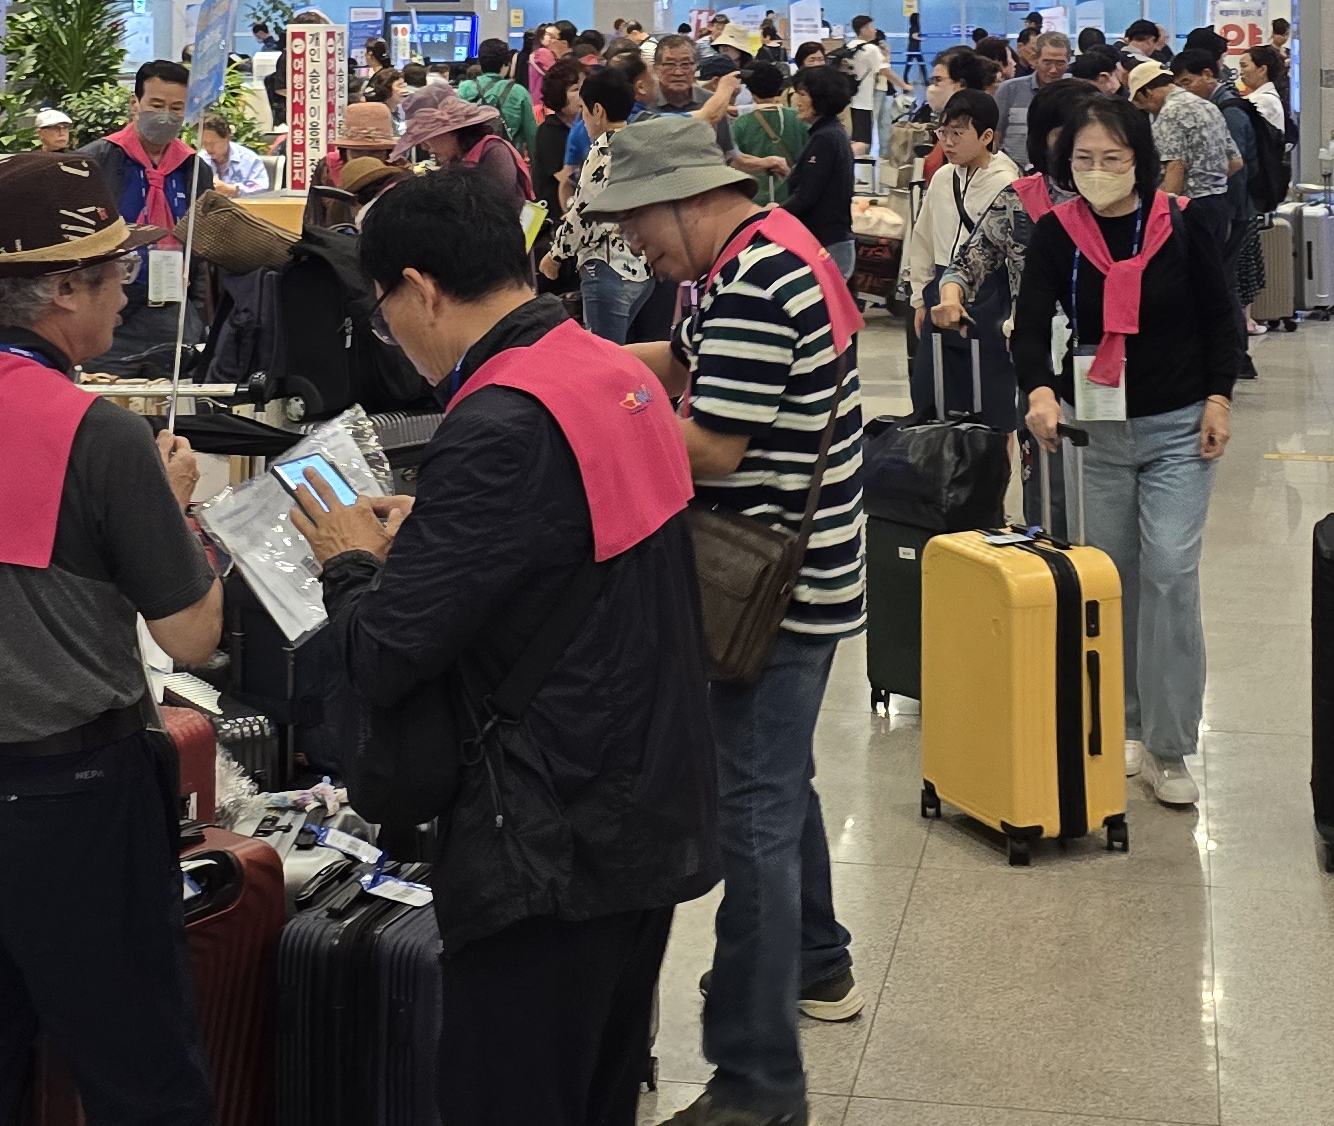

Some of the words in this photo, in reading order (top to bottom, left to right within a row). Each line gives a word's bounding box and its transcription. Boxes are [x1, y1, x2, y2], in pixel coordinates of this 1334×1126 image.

[308, 31, 321, 63] 개인
[292, 57, 306, 106] 여행사
[308, 68, 321, 100] 승선
[292, 112, 306, 145] 사용
[308, 105, 321, 152] 이용객
[292, 151, 306, 184] 금지
